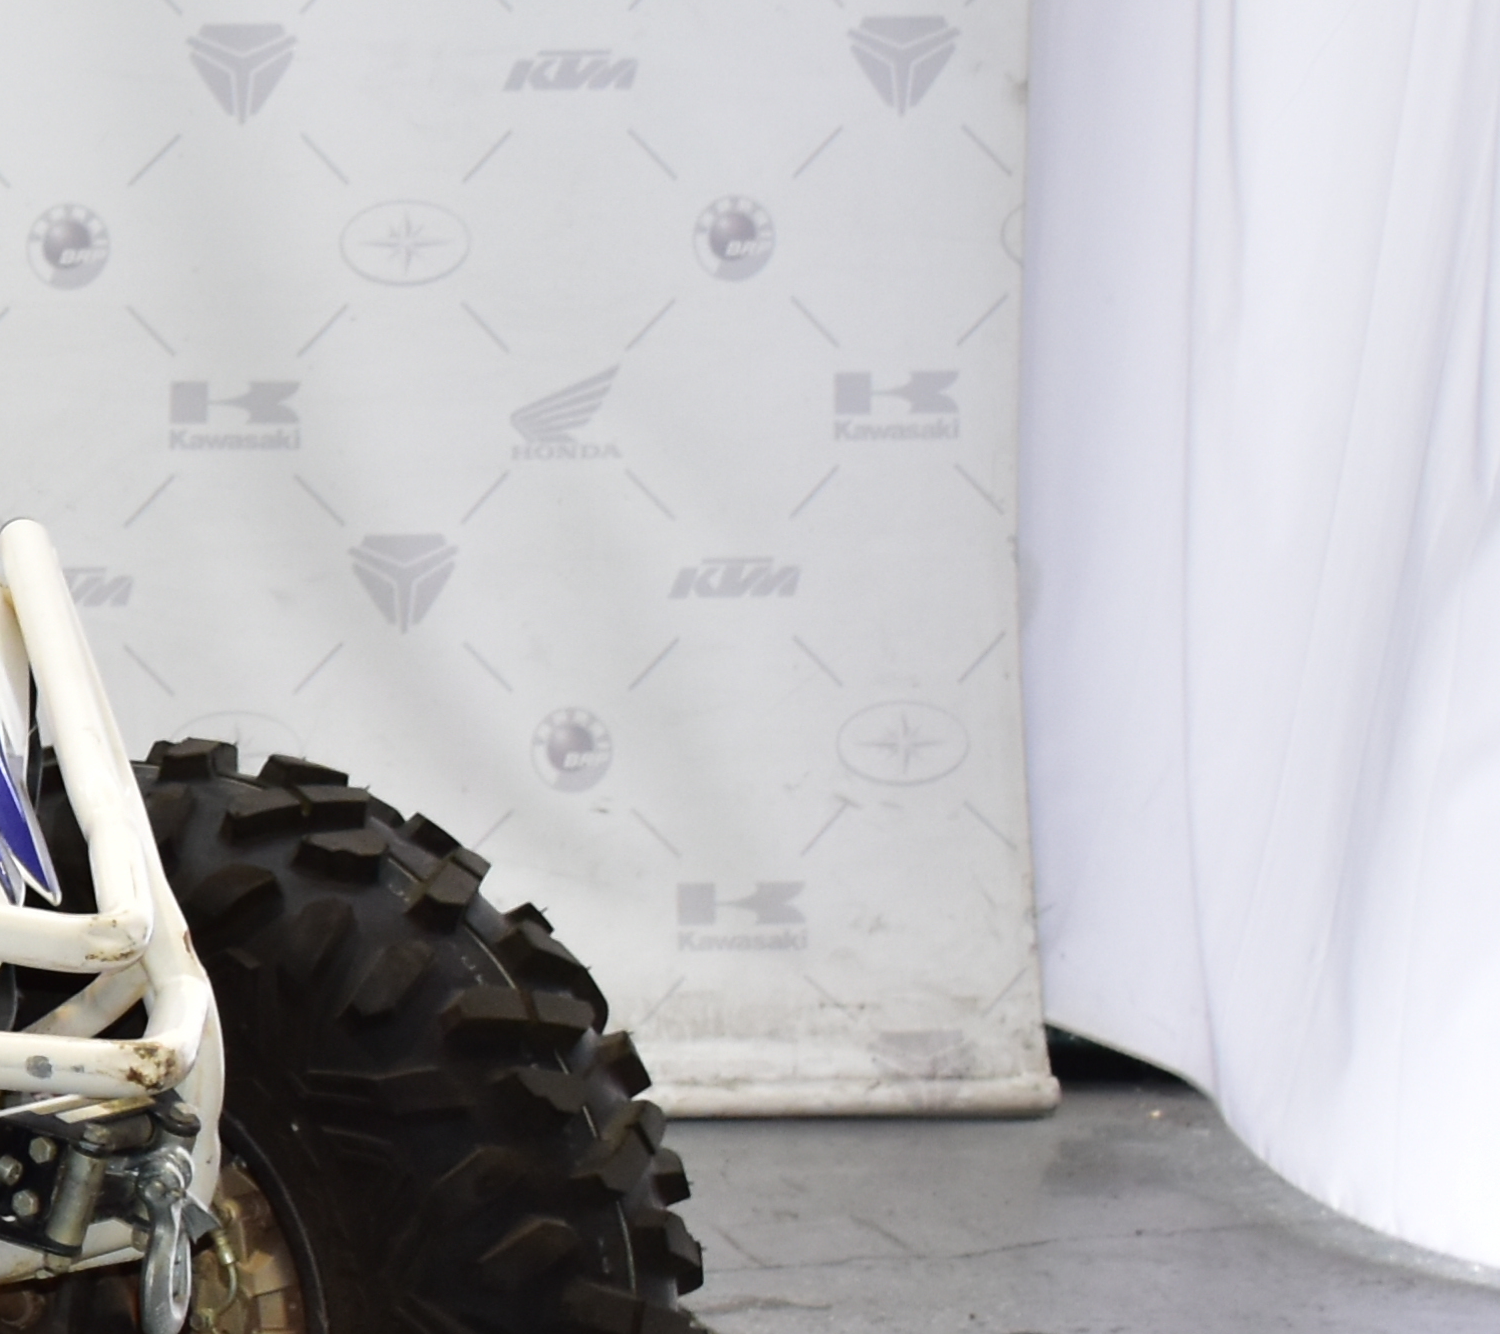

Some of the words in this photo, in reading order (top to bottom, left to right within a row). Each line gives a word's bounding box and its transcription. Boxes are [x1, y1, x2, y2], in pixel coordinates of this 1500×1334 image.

[504, 49, 638, 91] KTM
[169, 427, 301, 451] Kawasaki
[834, 417, 960, 440] Kawasaki
[511, 442, 623, 460] HONDA
[63, 566, 133, 607] TM
[669, 556, 801, 598] KTM
[677, 928, 805, 952] Kawasaki
